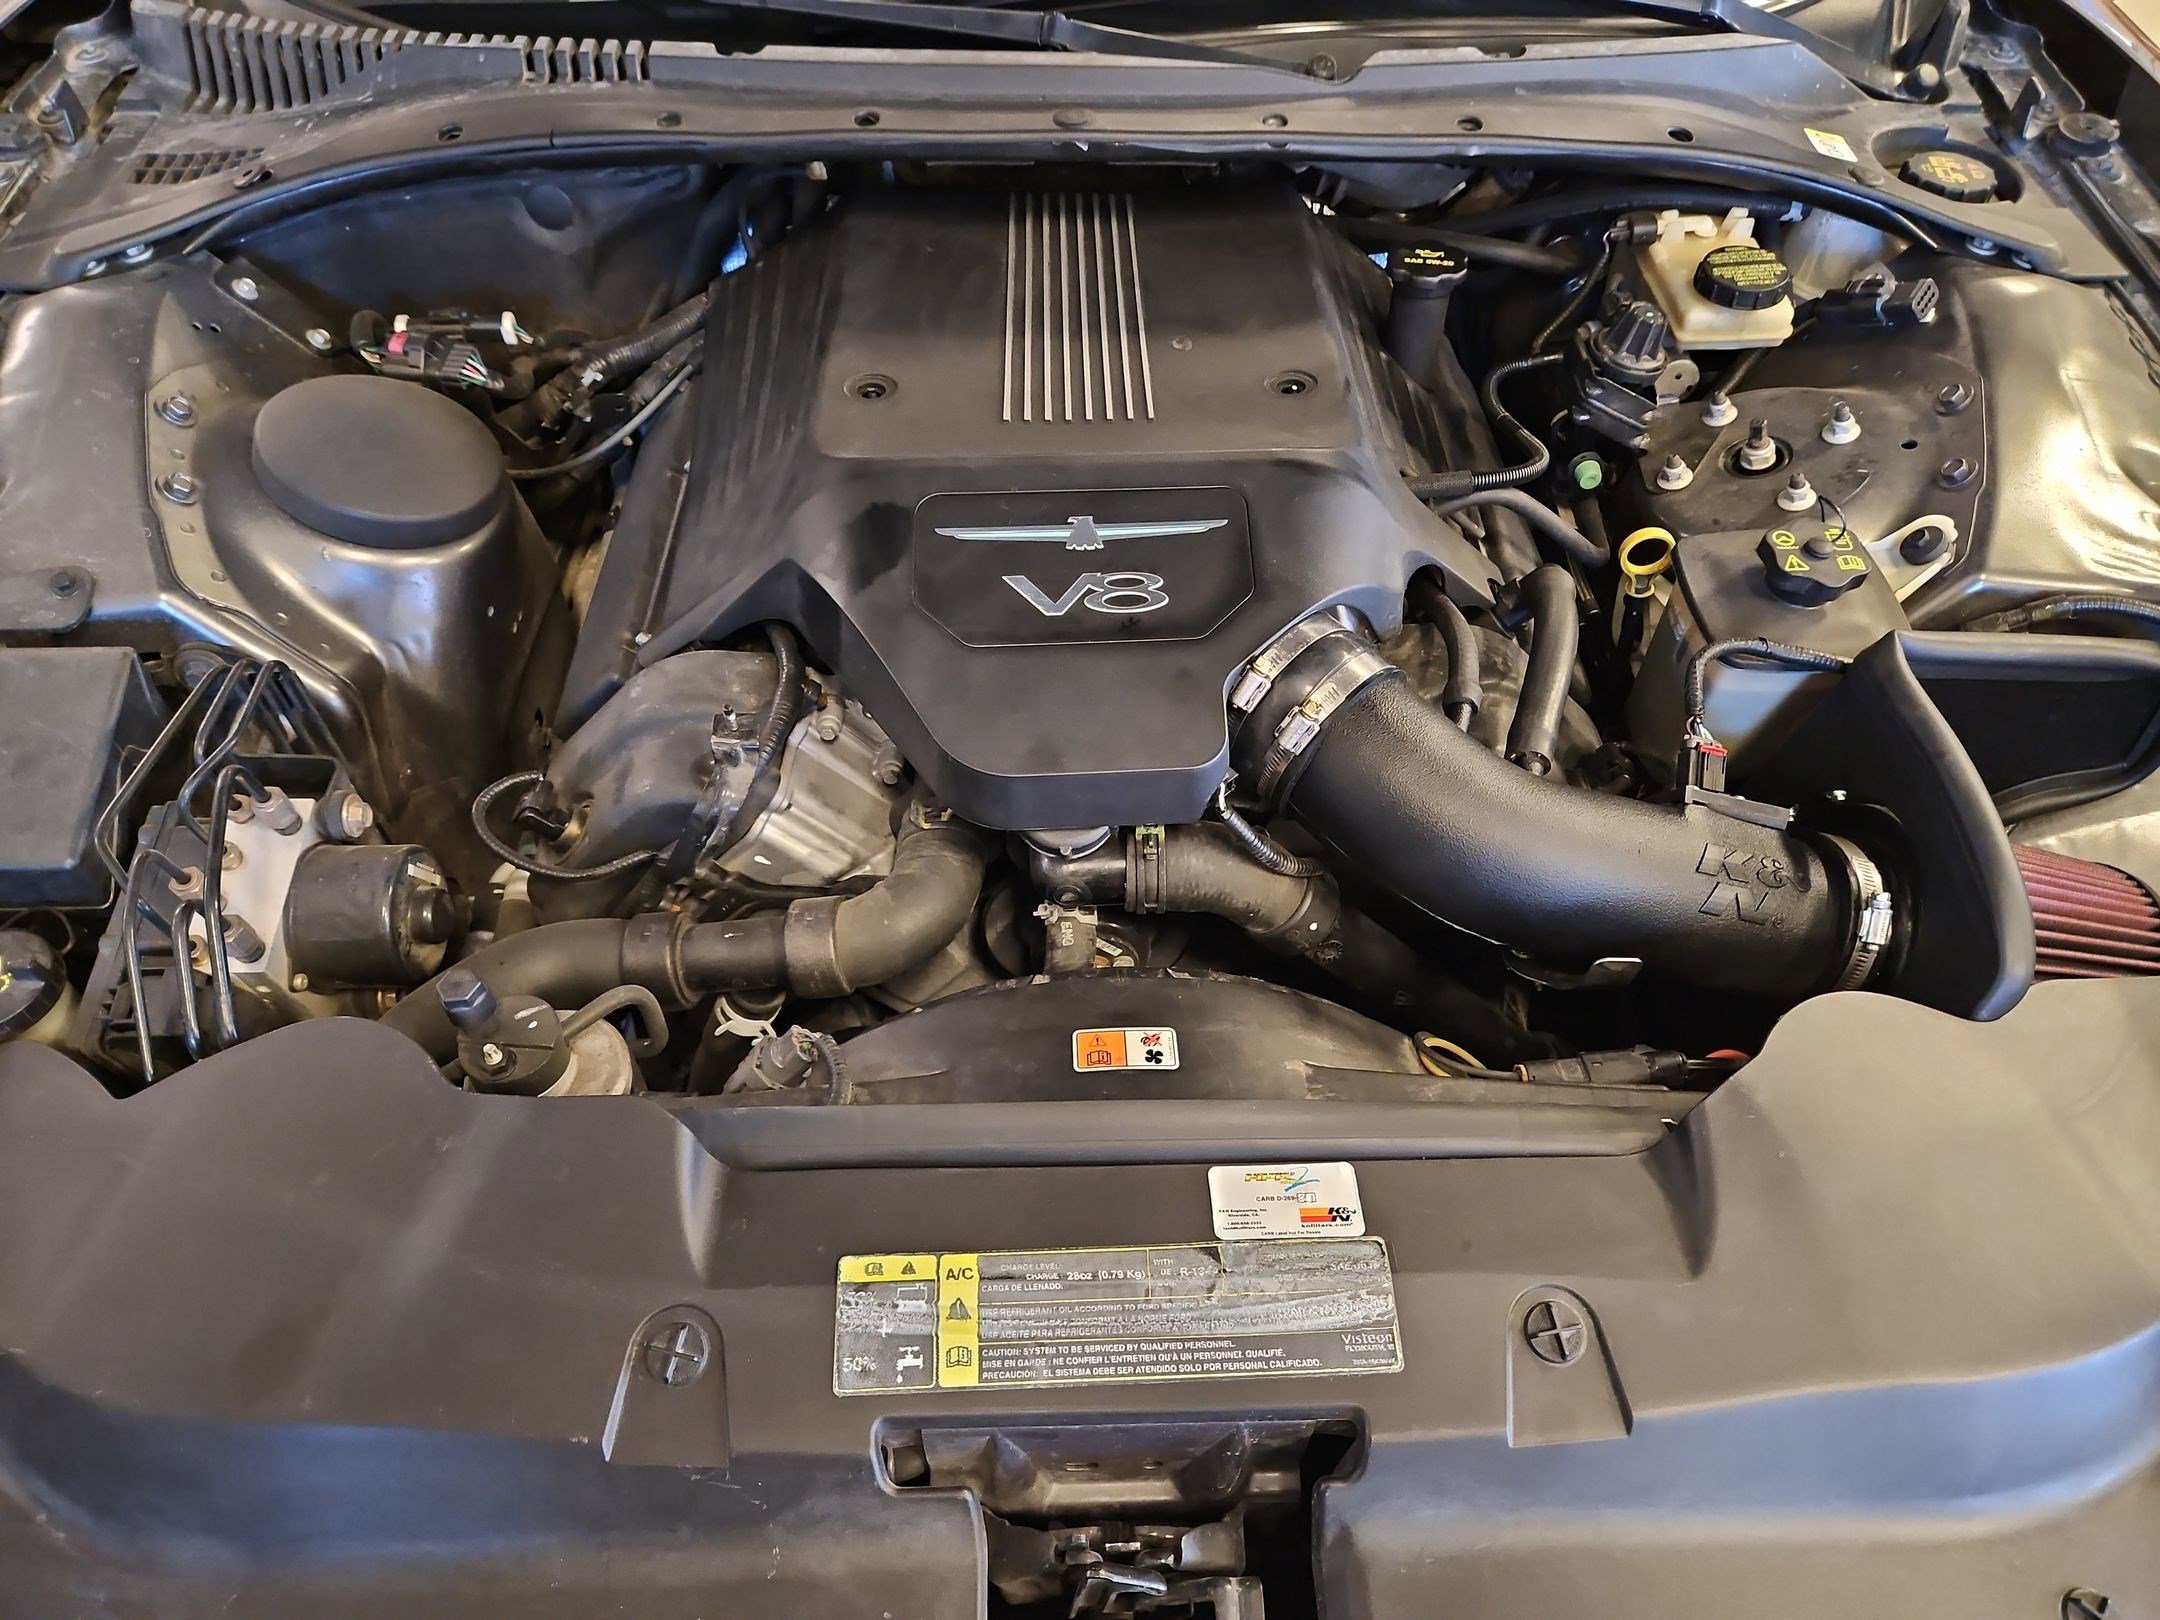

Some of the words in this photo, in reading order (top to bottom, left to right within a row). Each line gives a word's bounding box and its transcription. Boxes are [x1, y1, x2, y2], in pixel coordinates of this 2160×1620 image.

[1001, 571, 1169, 617] V8
[1001, 1263, 1034, 1272] CHARGE
[1153, 1258, 1174, 1266] WITH
[945, 1267, 974, 1281] A/C
[1098, 1269, 1125, 1280] (0.79
[1126, 1269, 1146, 1280] Kg)
[1180, 1265, 1219, 1277] R-13
[981, 1285, 1010, 1293] CARGA
[1011, 1283, 1022, 1291] DE
[999, 1306, 1057, 1318] REFRIGERANT
[1059, 1306, 1073, 1314] OIL
[1073, 1303, 1123, 1313] ACCORDING
[1124, 1303, 1136, 1311] TO
[1137, 1302, 1160, 1311] FORD
[999, 1329, 1030, 1339] ACEITE
[1031, 1328, 1053, 1338] PARA
[1054, 1324, 1123, 1337] REFRIGERANTES
[1341, 1332, 1393, 1345] Visteon
[981, 1348, 1021, 1357] CAUTION:
[1023, 1346, 1056, 1355] SYSTEM
[1058, 1346, 1069, 1354] TO
[1071, 1345, 1083, 1354] BE
[1084, 1344, 1126, 1353] SERVICED
[1126, 1343, 1139, 1351] BY
[1140, 1342, 1183, 1351] QUALIFIED
[1185, 1340, 1237, 1350] PERSONNEL.
[842, 1356, 877, 1373] 50%
[982, 1360, 1002, 1368] MISE
[1003, 1359, 1016, 1367] EN
[1053, 1357, 1064, 1365] NE
[1065, 1356, 1103, 1365] CONFIER
[1104, 1353, 1157, 1364] L'ENTRETIEN
[1180, 1352, 1192, 1360] UN
[1193, 1351, 1244, 1360] PERSONNEL
[1245, 1348, 1287, 1358] QUALIFIÉ.
[982, 1369, 1039, 1380] PRECAUCIÓN:
[1042, 1369, 1053, 1377] EL
[1055, 1367, 1091, 1377] SISTEMA
[1092, 1366, 1116, 1375] DEBE
[1117, 1365, 1134, 1375] SER
[1135, 1364, 1177, 1374] ATENDIDO
[1178, 1363, 1202, 1373] SOLO
[1203, 1362, 1221, 1371] POR
[1222, 1361, 1268, 1371] PERSONAL
[1269, 1358, 1323, 1369] CALIFICADO.
